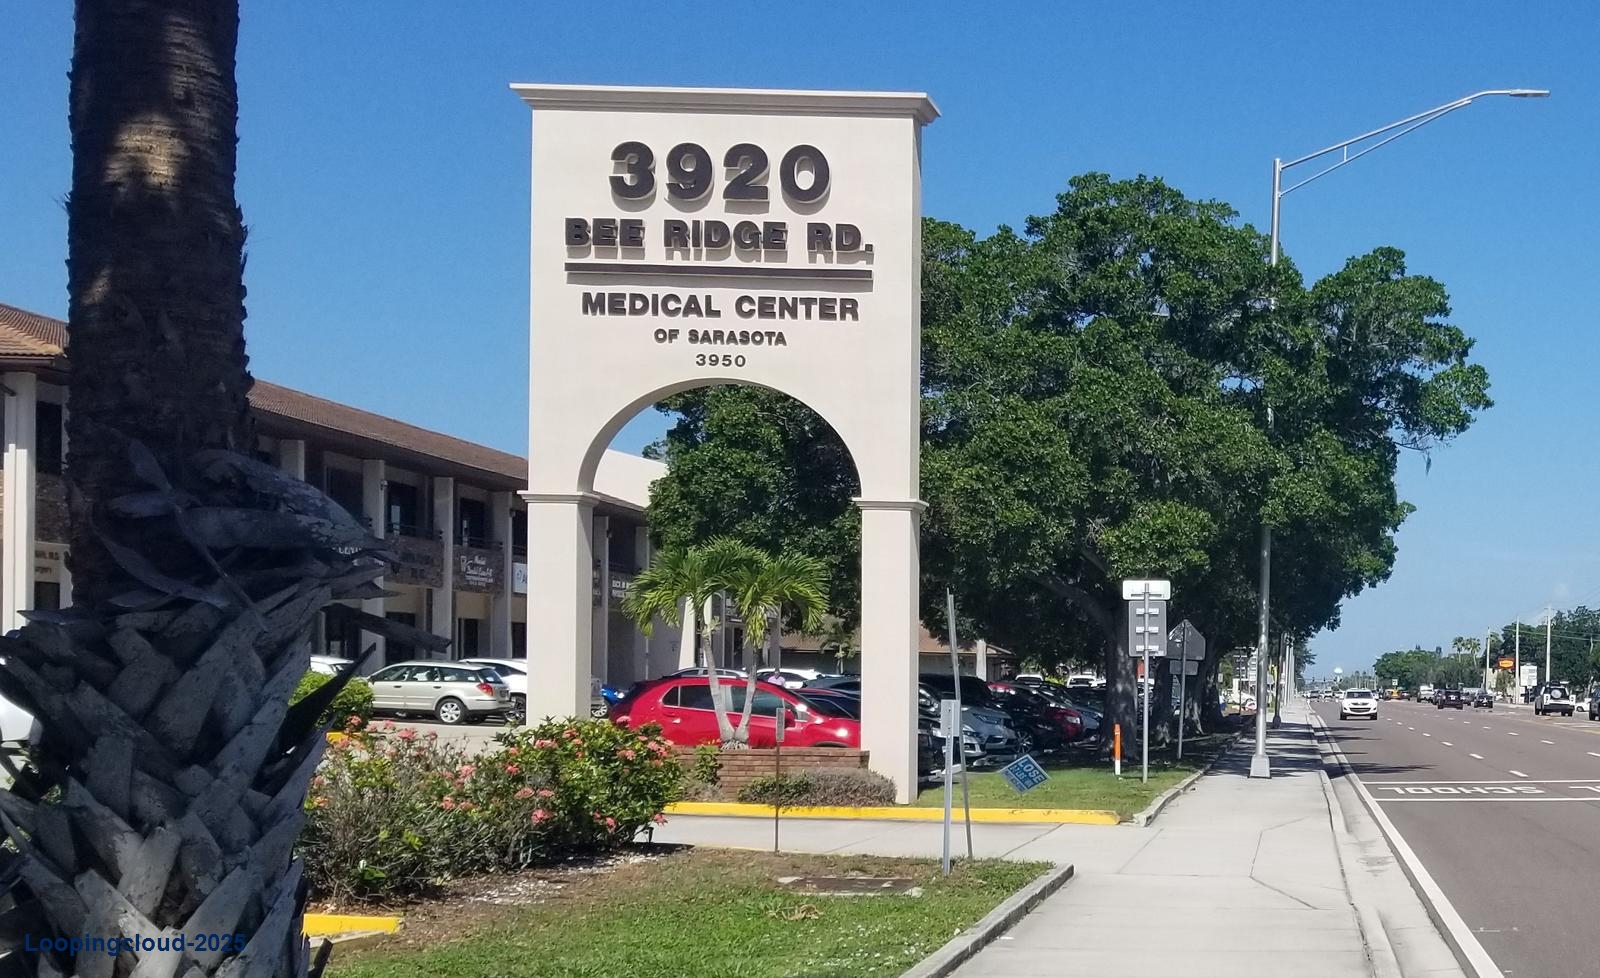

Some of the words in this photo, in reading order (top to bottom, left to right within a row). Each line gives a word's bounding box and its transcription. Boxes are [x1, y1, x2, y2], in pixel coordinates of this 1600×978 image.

[609, 141, 831, 202] 3920
[565, 217, 645, 248] BEE
[664, 219, 788, 252] RIDGE
[807, 222, 874, 253] RD.
[582, 292, 721, 318] MEDICAL
[735, 296, 860, 321] CENTER
[654, 328, 680, 343] OF
[688, 329, 787, 346] SARASOTA
[696, 354, 746, 367] 3950
[1017, 758, 1046, 784] LOSE
[1377, 785, 1546, 795] SCHOOL
